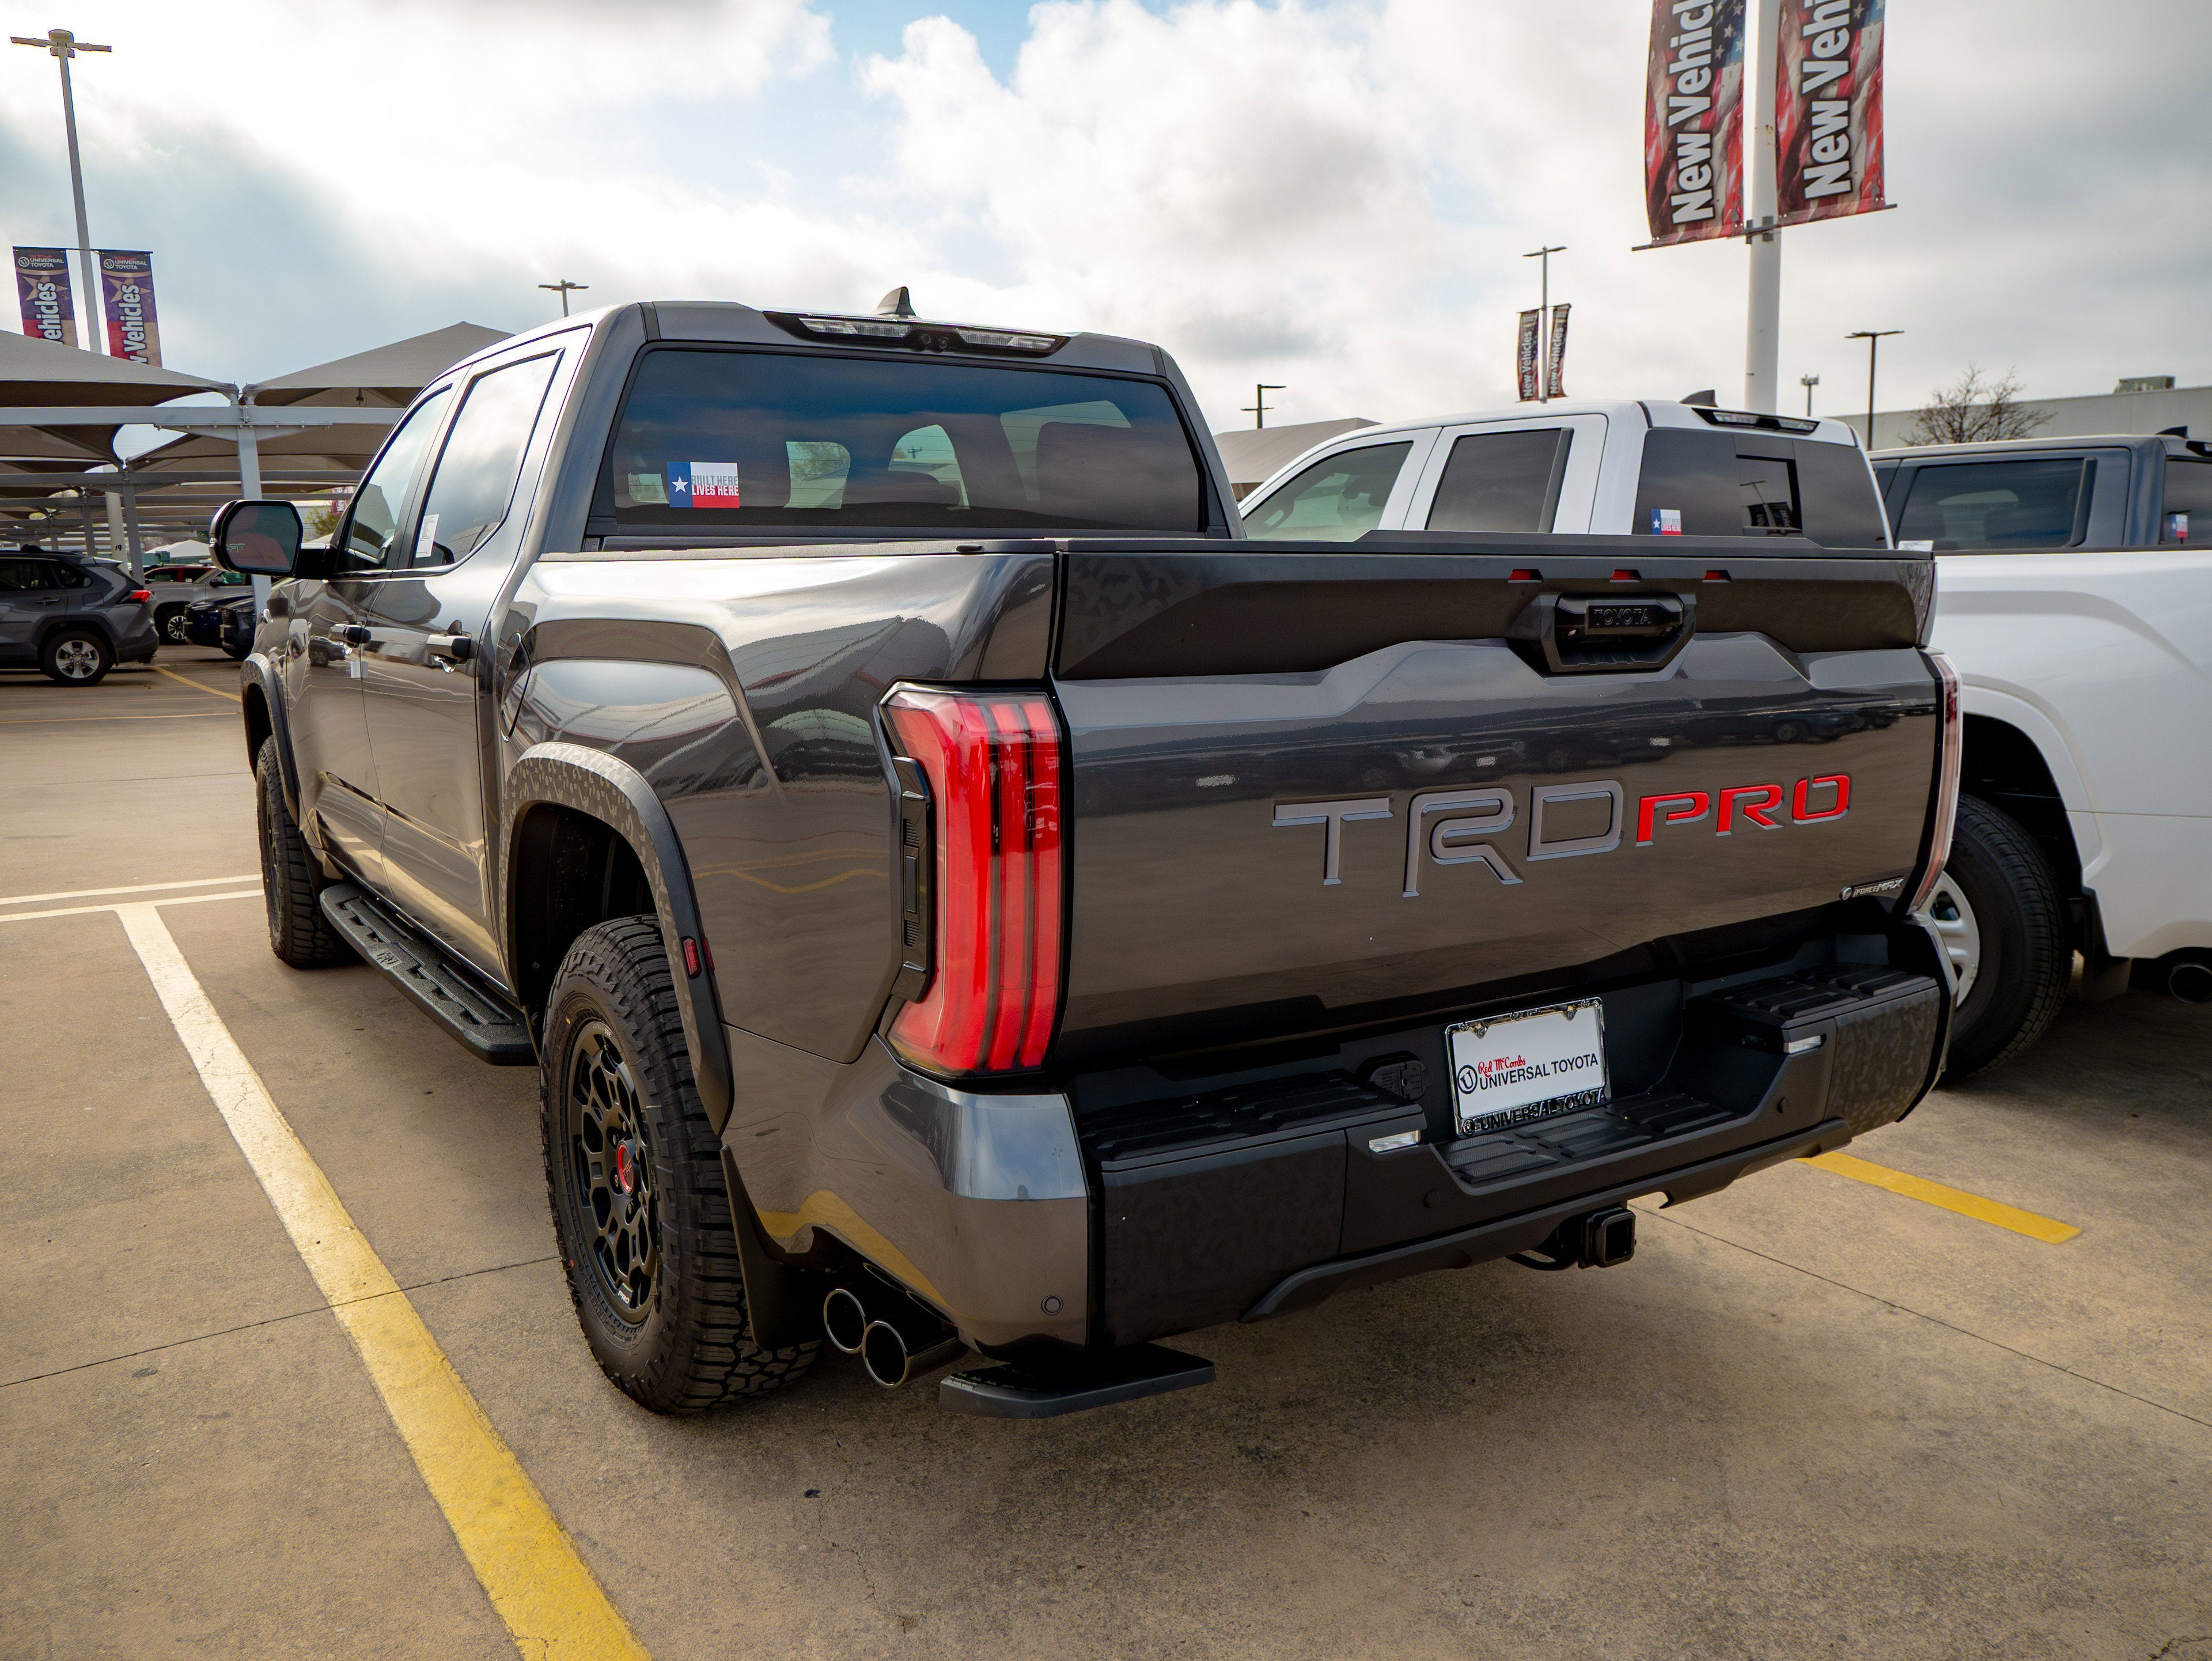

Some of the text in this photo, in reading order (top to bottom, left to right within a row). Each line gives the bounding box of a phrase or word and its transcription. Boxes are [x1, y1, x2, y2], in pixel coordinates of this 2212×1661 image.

[1802, 0, 1853, 199] New Veh
[1671, 133, 1715, 224] New
[35, 282, 63, 344] ehicles
[119, 284, 146, 352] Vehicles
[1521, 331, 1532, 373] Vehicles
[1551, 327, 1563, 370] Vehicles
[1523, 375, 1533, 397] New
[1550, 373, 1559, 394] New
[692, 475, 738, 486] BUILT HERE
[692, 485, 739, 496] LIVES HERE
[1593, 608, 1652, 625] TOYOTA
[1272, 774, 1851, 898] TRD PRO
[1876, 879, 1904, 892] MAX
[1478, 1054, 1526, 1078] Red McCombs
[1479, 1053, 1599, 1090] UNIVERSAL TOYOTA
[1479, 1088, 1607, 1131] UNIVERSAL TOYOTA
[618, 1290, 630, 1304] PRO
